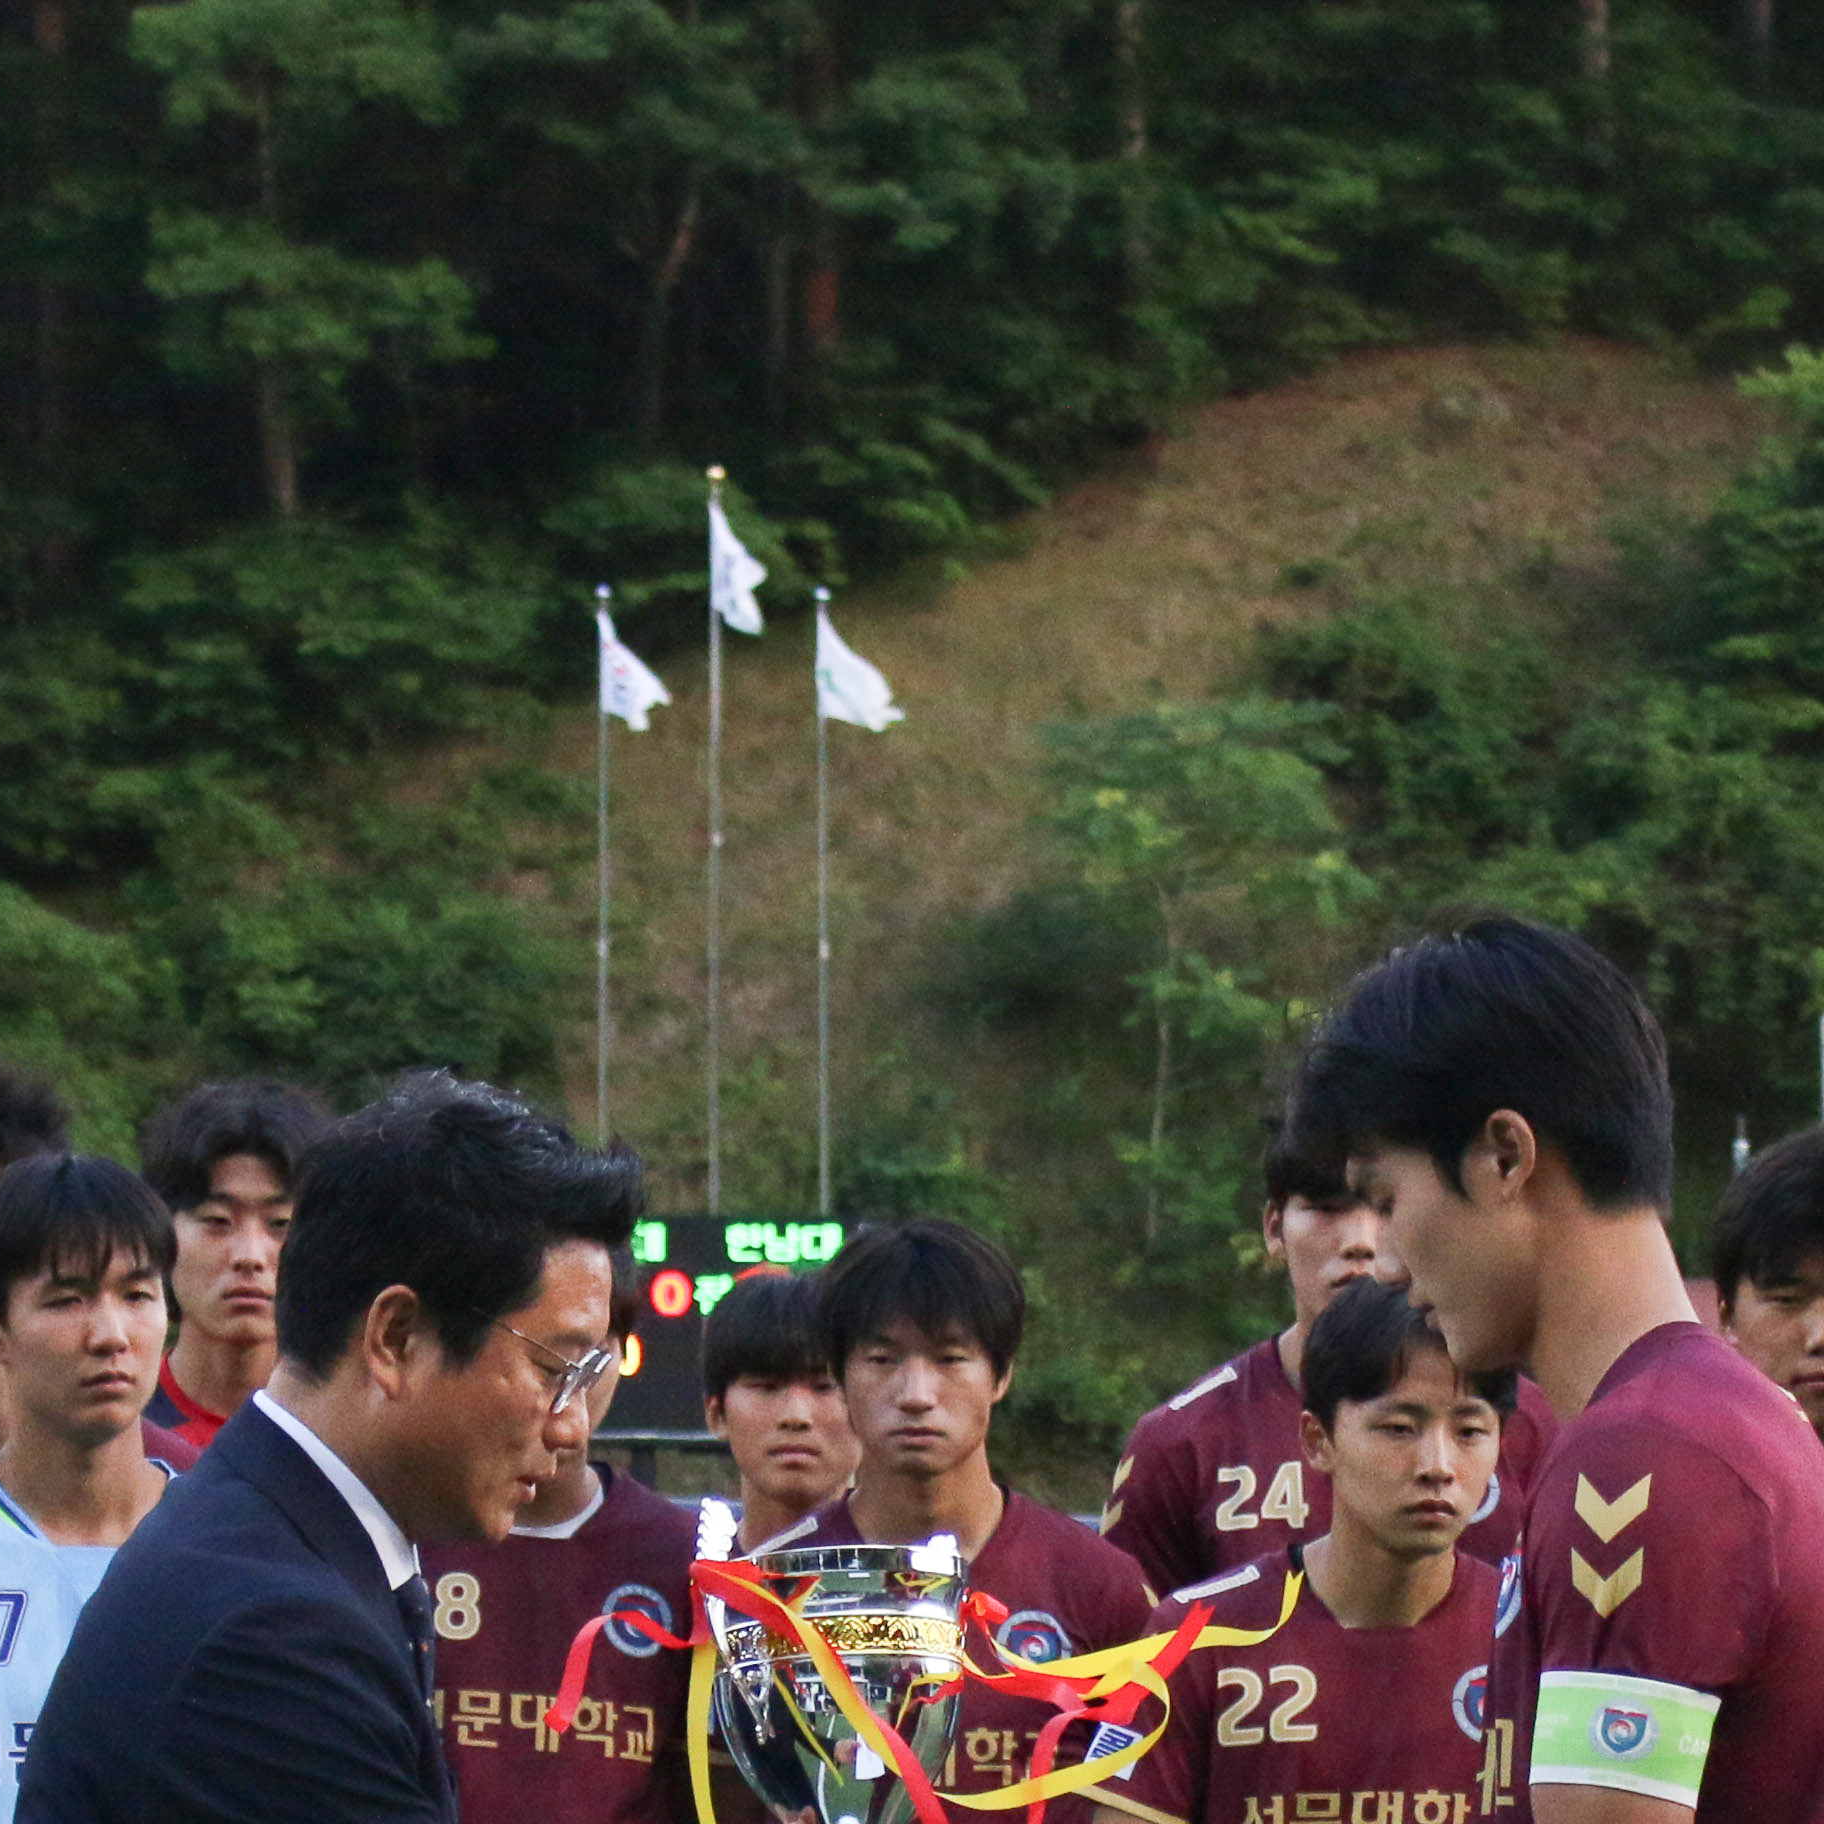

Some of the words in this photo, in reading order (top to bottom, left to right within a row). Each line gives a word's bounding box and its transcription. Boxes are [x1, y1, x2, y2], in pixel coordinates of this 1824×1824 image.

[650, 1269, 693, 1317] 0
[1216, 1461, 1309, 1532] 24
[433, 1571, 481, 1641] 8
[434, 1688, 656, 1764] 문대학교
[1217, 1664, 1319, 1748] 22
